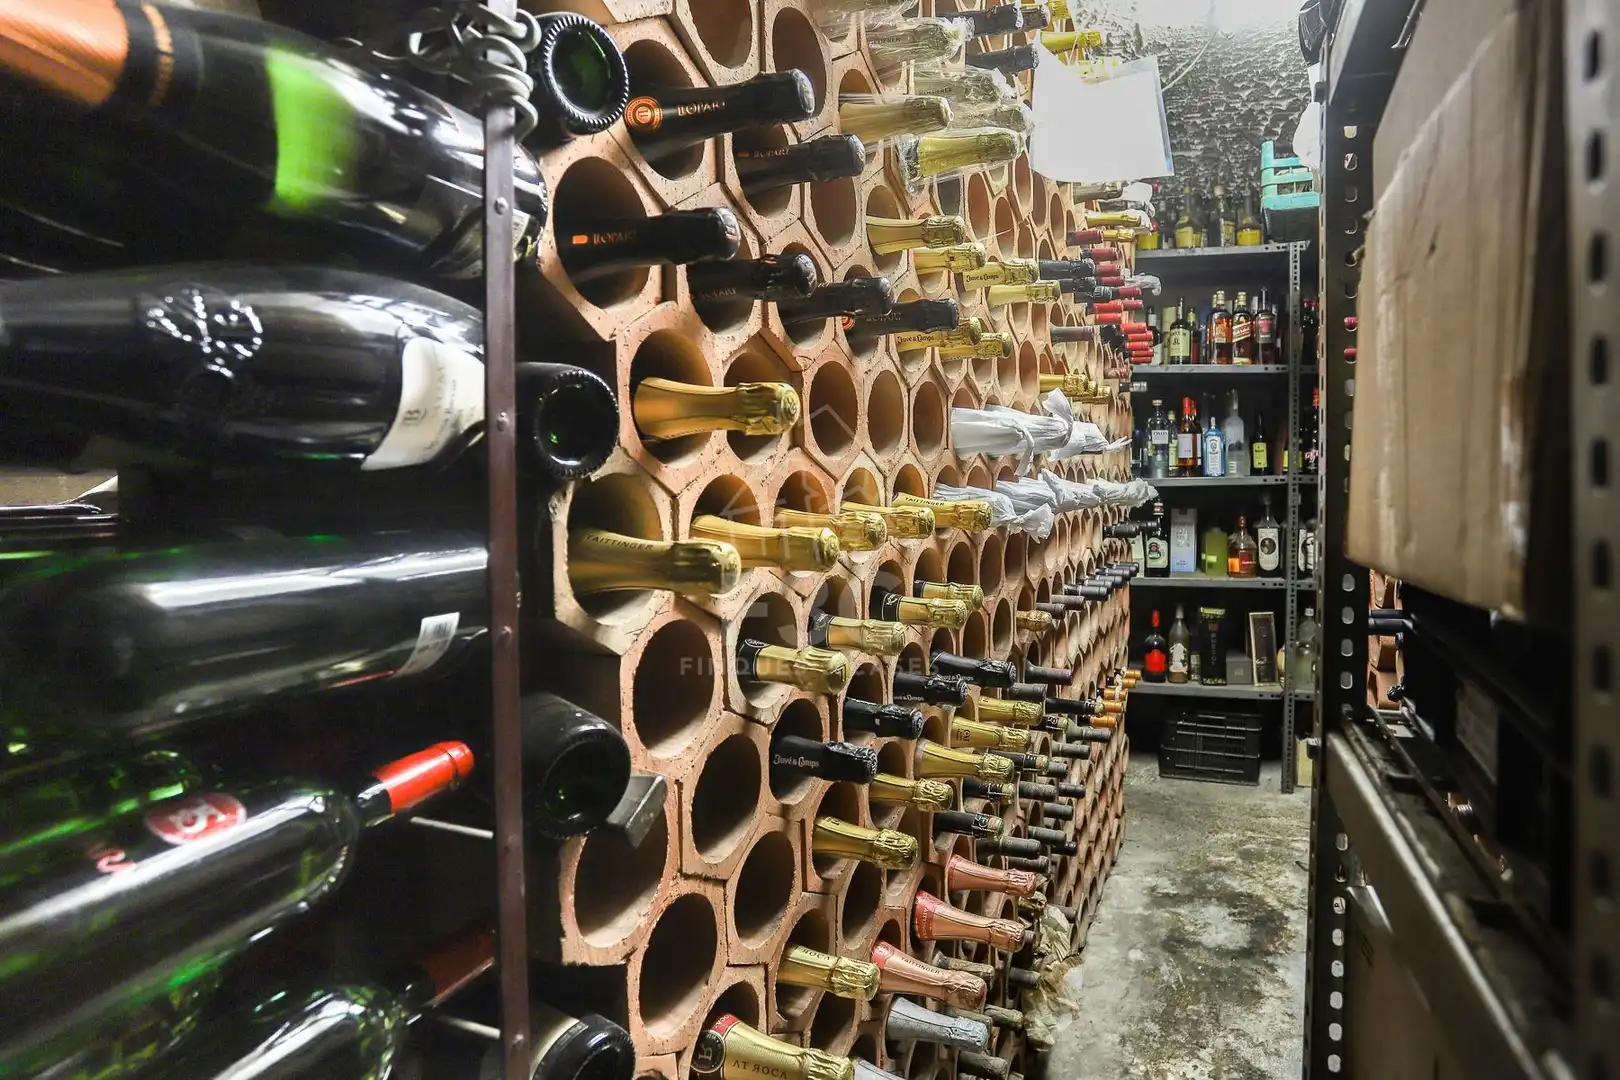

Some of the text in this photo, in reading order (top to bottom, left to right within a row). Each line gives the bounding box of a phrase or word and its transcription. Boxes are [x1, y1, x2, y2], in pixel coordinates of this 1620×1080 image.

[905, 496, 945, 506] TAITTINGER
[585, 532, 654, 550] TAITTINGER
[773, 753, 820, 769] Juvé & Camps
[901, 956, 941, 975] TAITTINGER
